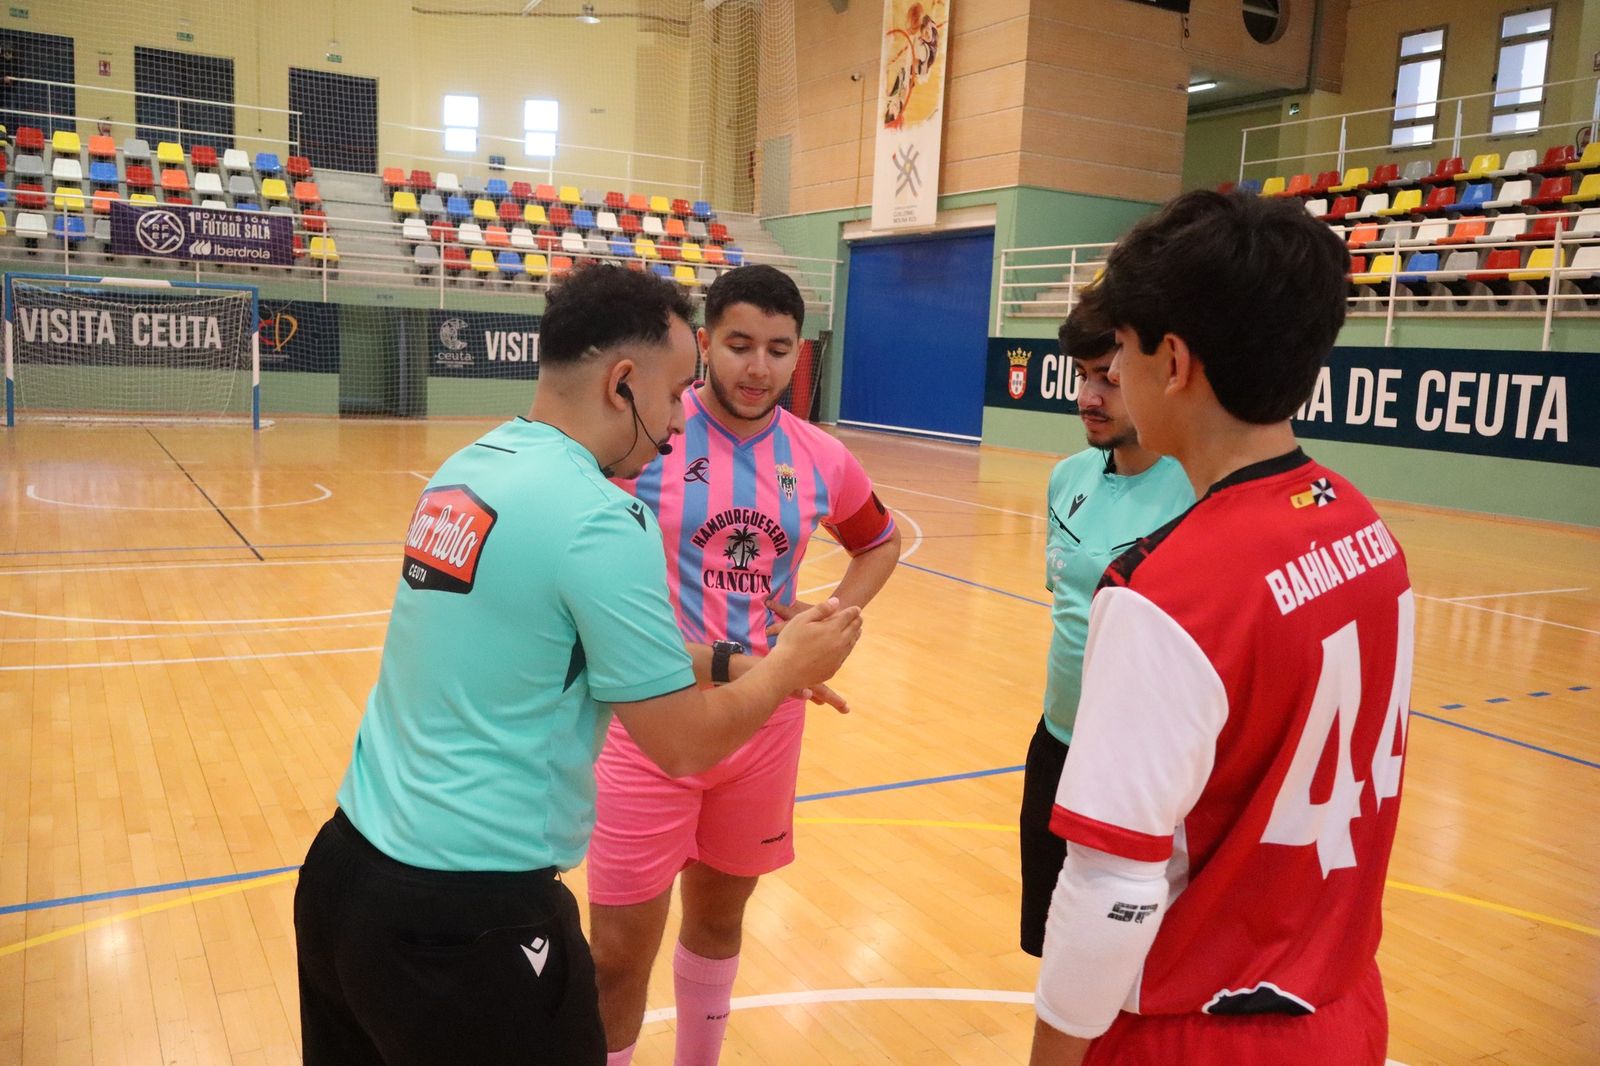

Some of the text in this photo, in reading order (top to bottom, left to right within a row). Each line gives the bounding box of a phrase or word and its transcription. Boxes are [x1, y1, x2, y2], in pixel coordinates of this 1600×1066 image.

[202, 212, 269, 225] DIVISIÓN
[202, 218, 270, 240] FÚTBOL SALA
[214, 244, 270, 259] Iberdrola
[19, 307, 222, 349] VISITA CEUTA
[485, 330, 541, 363] VISIT
[1346, 367, 1402, 428] DE
[1415, 369, 1568, 443] CEUTA
[692, 508, 789, 557] HAMBURGUESERIA
[408, 563, 428, 583] CEUTA
[703, 569, 772, 594] CANCÚN
[1265, 540, 1345, 617] BAHÍA
[1331, 535, 1367, 581] DE
[1259, 587, 1416, 881] 44
